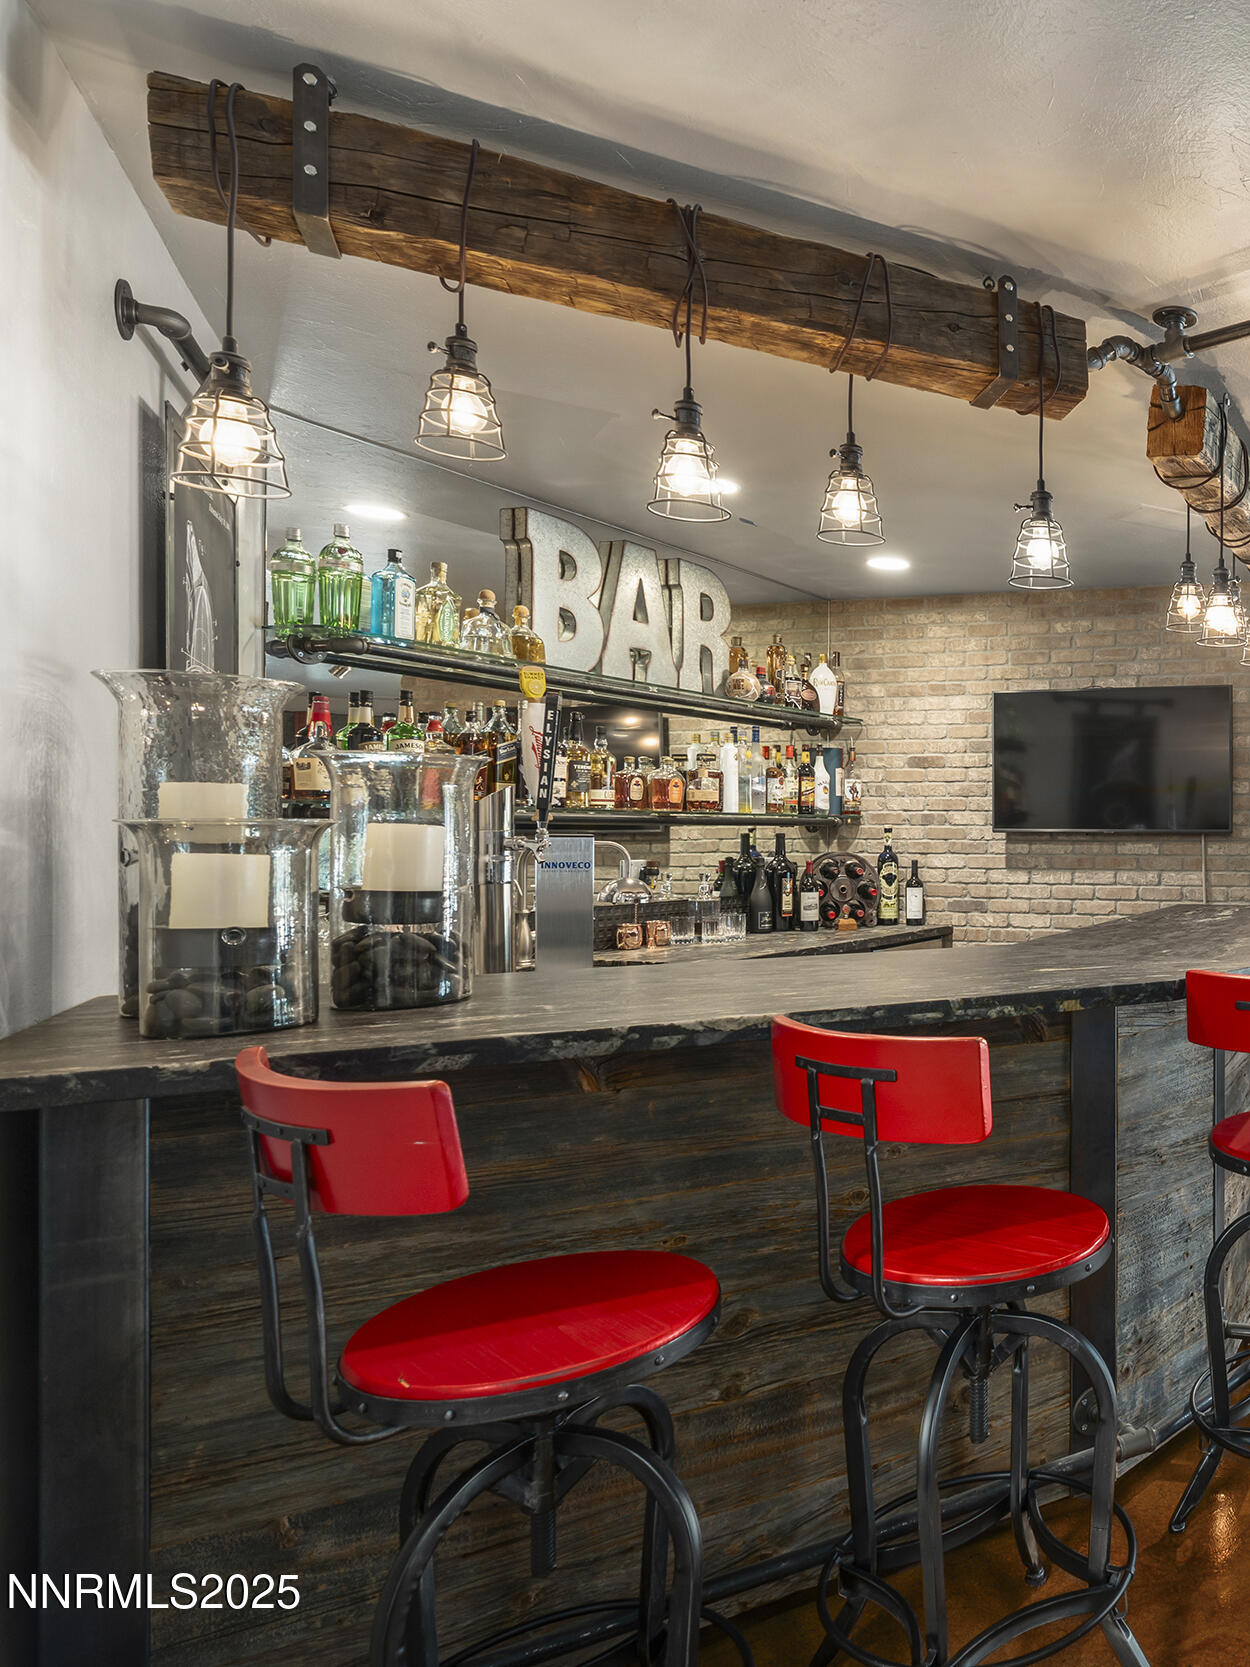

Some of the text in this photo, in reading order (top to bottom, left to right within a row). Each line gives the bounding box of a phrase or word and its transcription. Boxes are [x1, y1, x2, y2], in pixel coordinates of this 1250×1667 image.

[500, 507, 731, 699] BAR
[538, 709, 555, 799] ELYSIAN
[541, 861, 592, 869] INNOVECO
